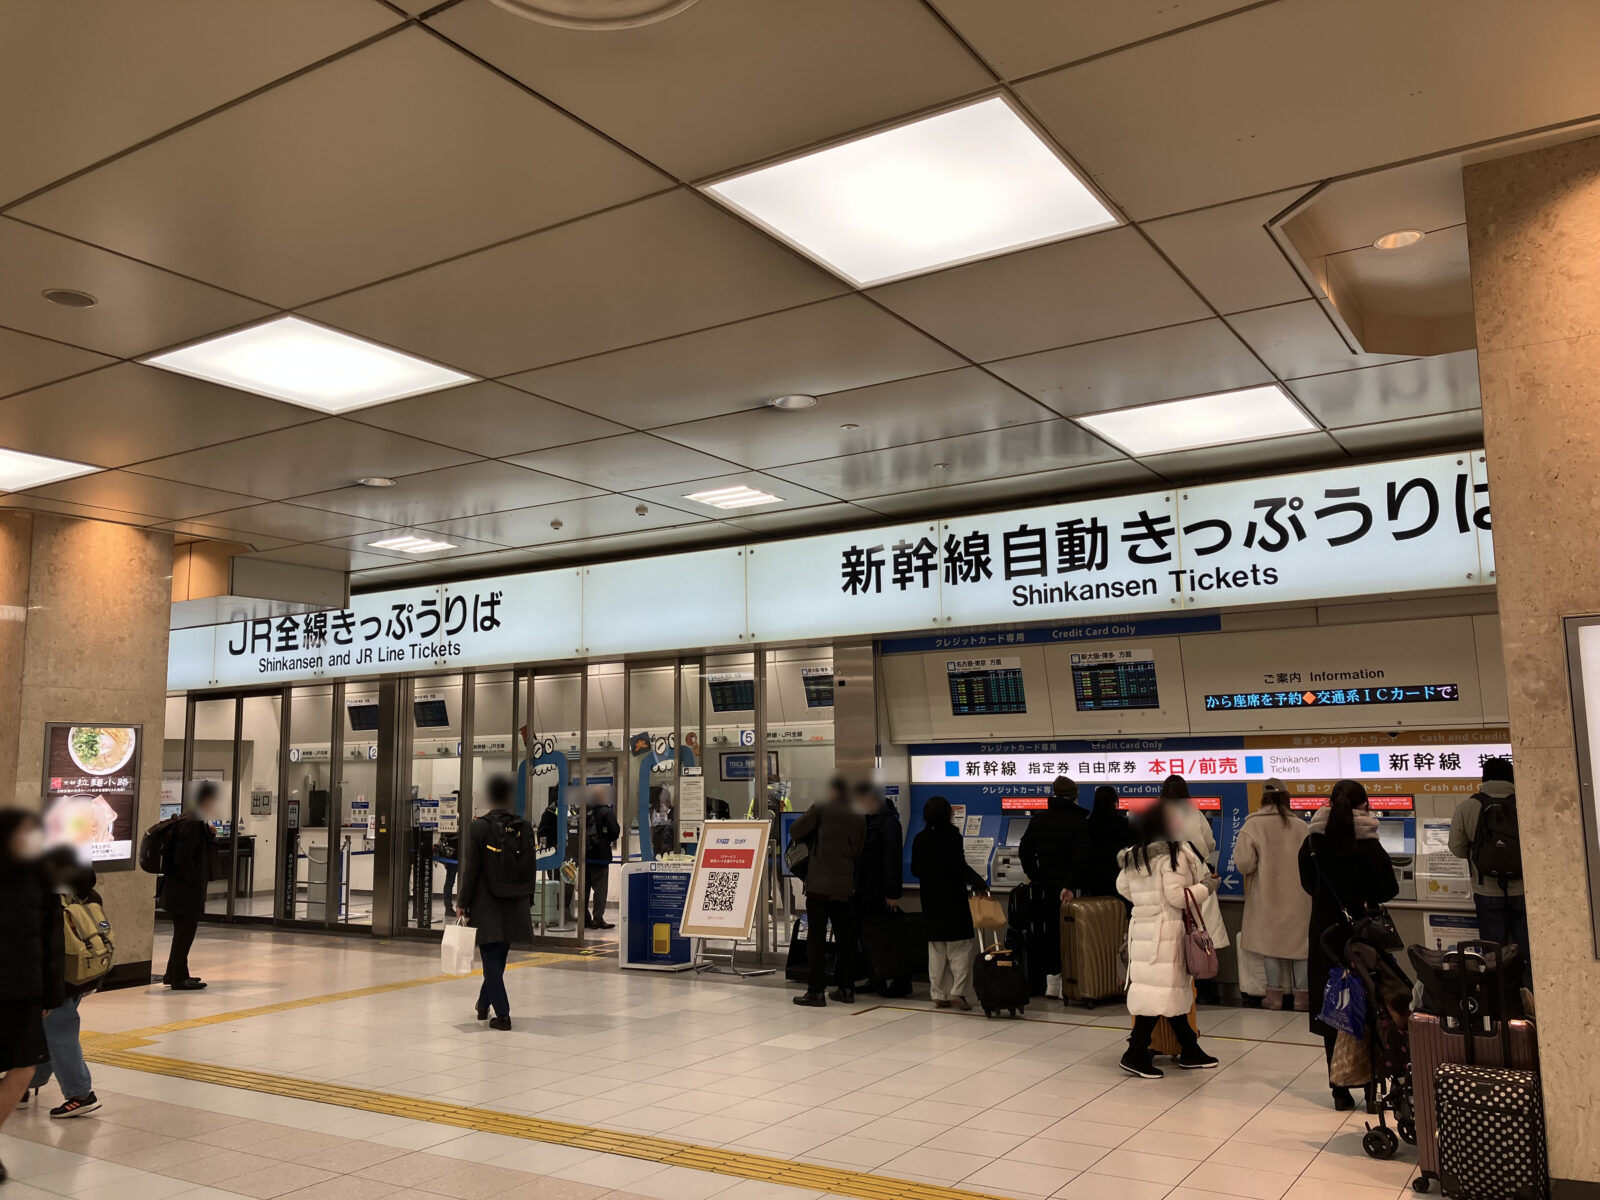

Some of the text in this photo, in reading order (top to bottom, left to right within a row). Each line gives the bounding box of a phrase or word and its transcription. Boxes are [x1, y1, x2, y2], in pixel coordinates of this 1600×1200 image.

[1012, 563, 1279, 607] Shinkansen Tickets
[228, 590, 503, 656] JR全線きっぷうりば
[1052, 623, 1136, 639] Credit Card Only
[935, 632, 1025, 648] クレジットカード専用
[258, 640, 461, 673] Shinkansen and JR Line Tickets
[1264, 672, 1302, 684] ご案内
[1310, 669, 1385, 682] Information
[1419, 732, 1508, 743] Cash and Credit
[1120, 741, 1139, 749] Card
[1142, 740, 1163, 750] Only
[1270, 755, 1320, 764] Shinkansen
[1389, 752, 1461, 771] 新幹線
[965, 757, 1238, 776] 新幹線 指定券 自由席券 本日/前売
[1271, 765, 1300, 774] Tickets
[982, 786, 1054, 794] クレジットカード専
[1122, 785, 1143, 793] Card
[1423, 783, 1449, 792] Cash
[1452, 783, 1473, 791] and
[252, 794, 270, 807] 出口
[289, 806, 297, 826] 出口
[1226, 807, 1240, 872] クレジットカ専用
